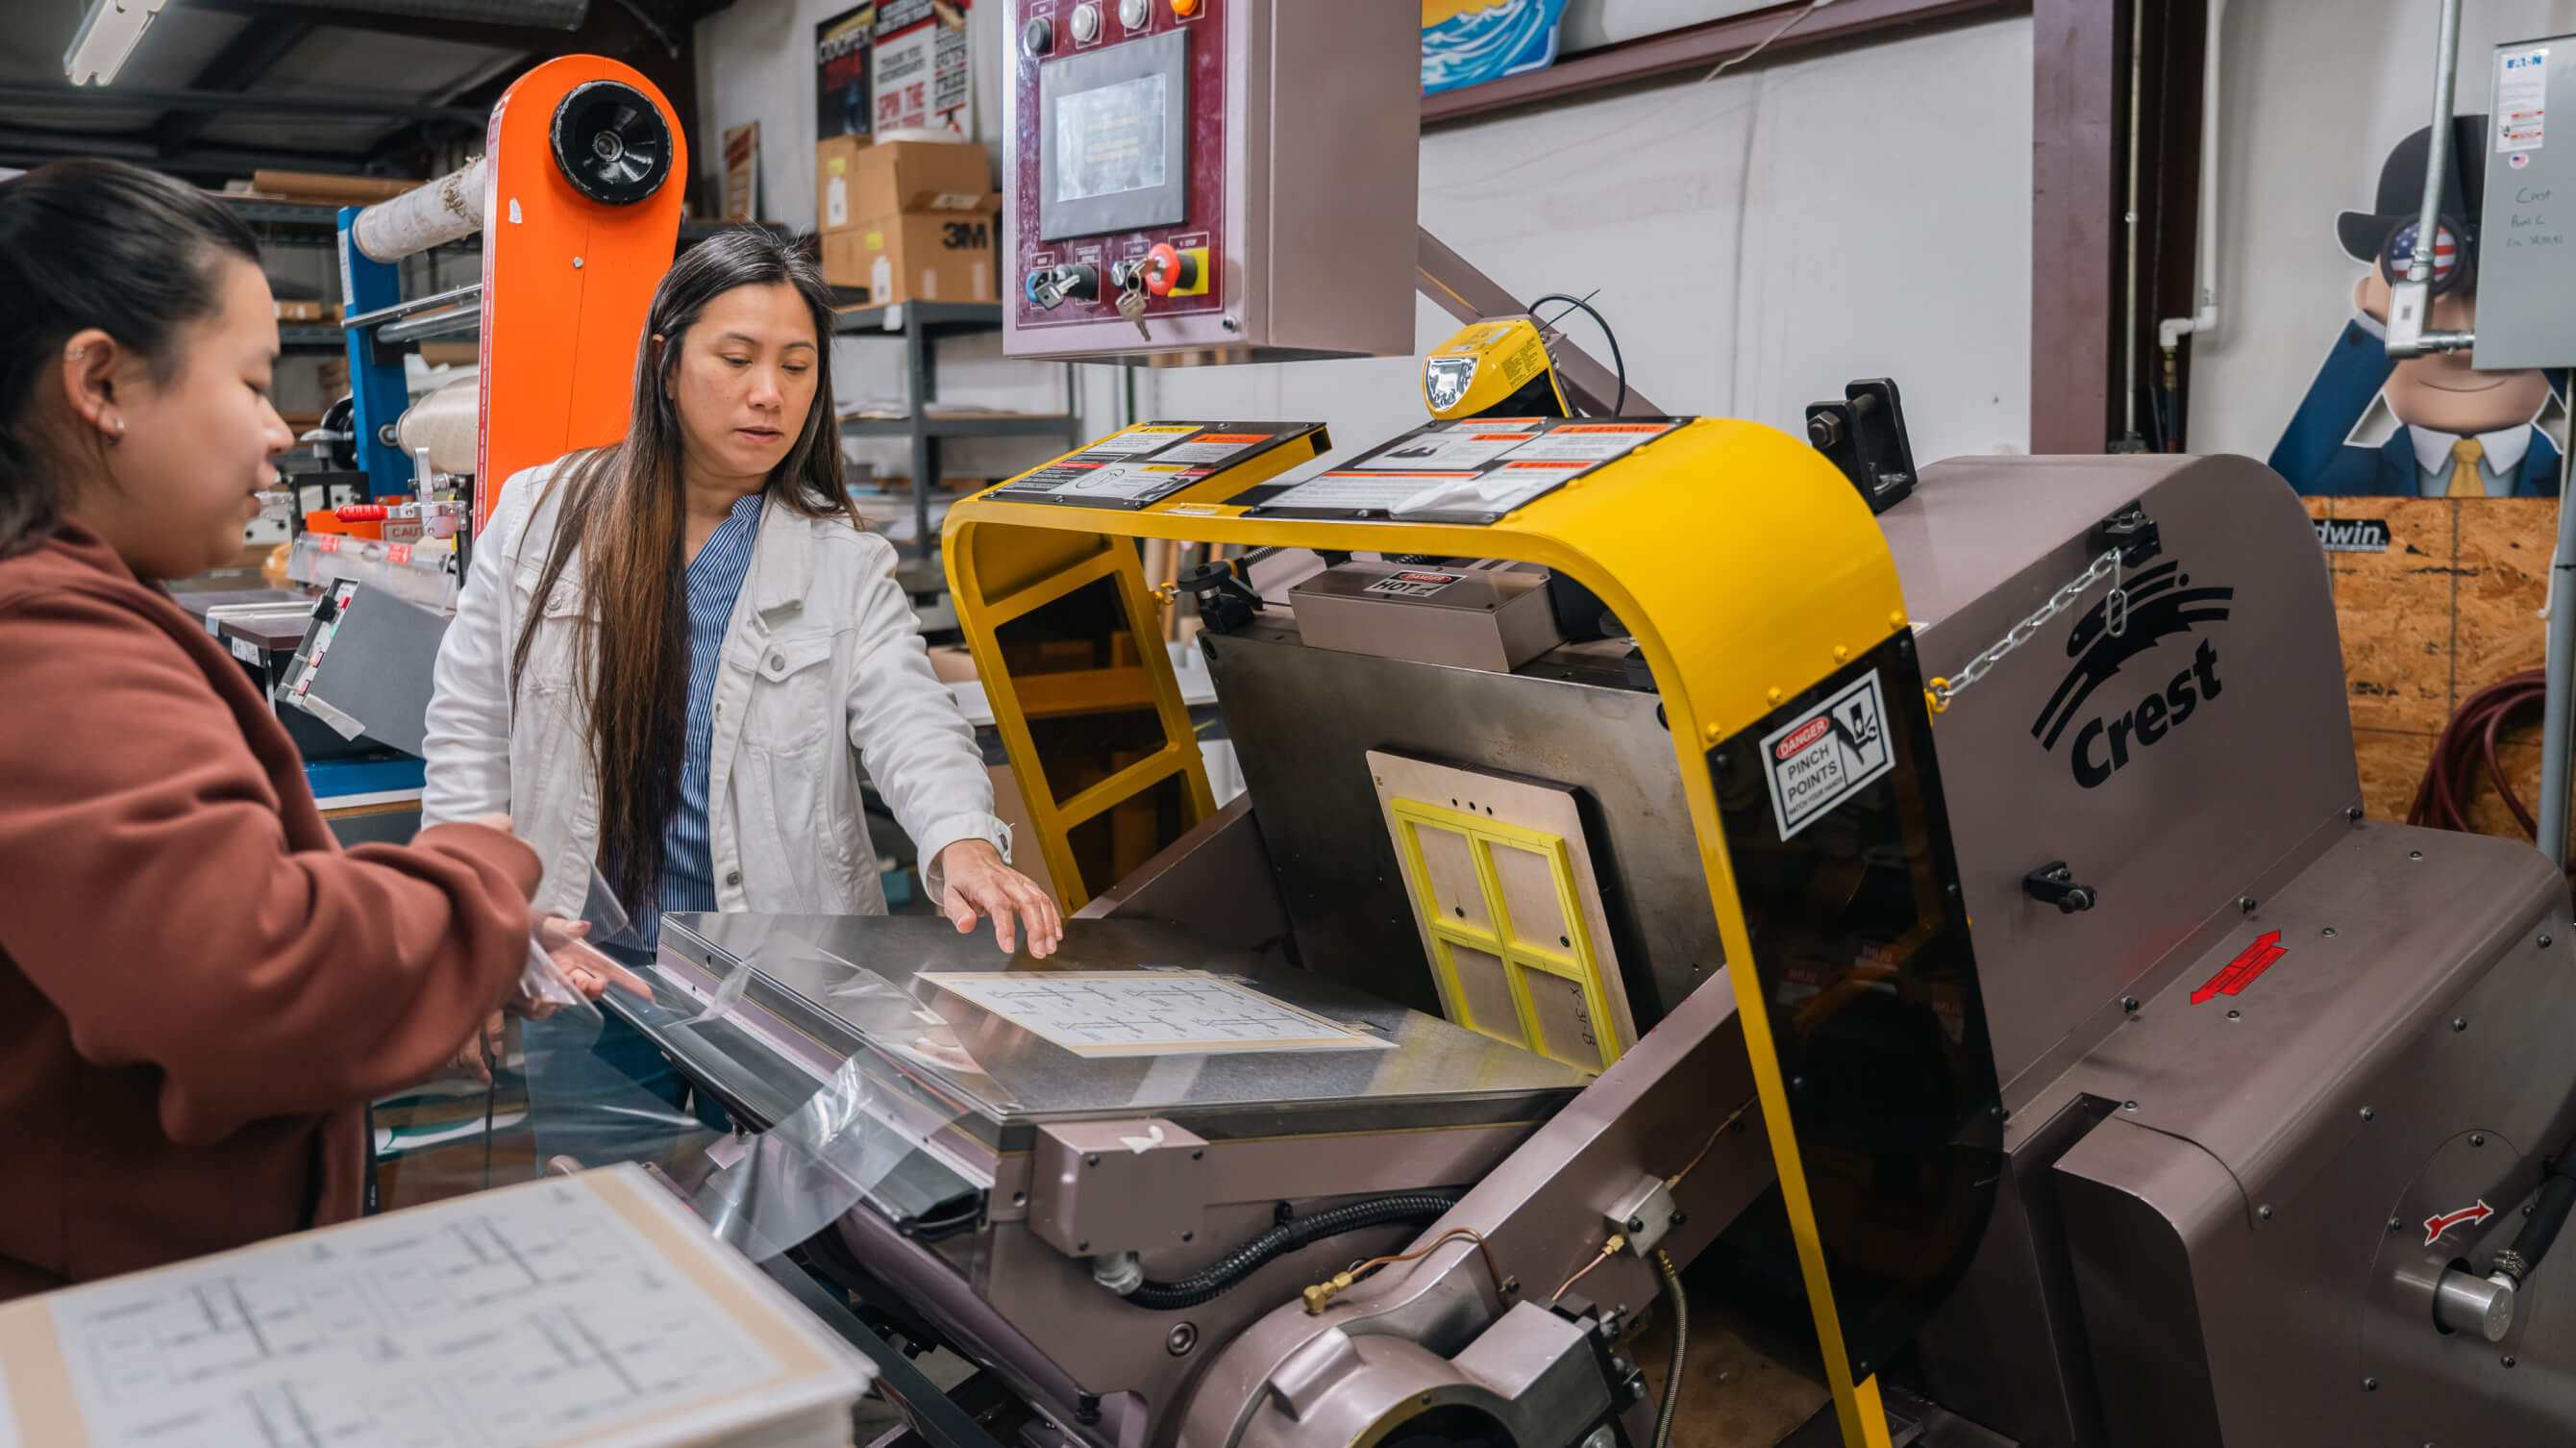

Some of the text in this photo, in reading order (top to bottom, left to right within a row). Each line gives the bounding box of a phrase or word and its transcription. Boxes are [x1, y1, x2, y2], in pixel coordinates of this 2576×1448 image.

[942, 222, 988, 250] 3M
[1375, 580, 1422, 592] HOT
[2071, 637, 2223, 788] Crest
[1779, 720, 1826, 757] DANGER
[1787, 742, 1830, 781] PINCH
[1787, 760, 1838, 803] POINTS
